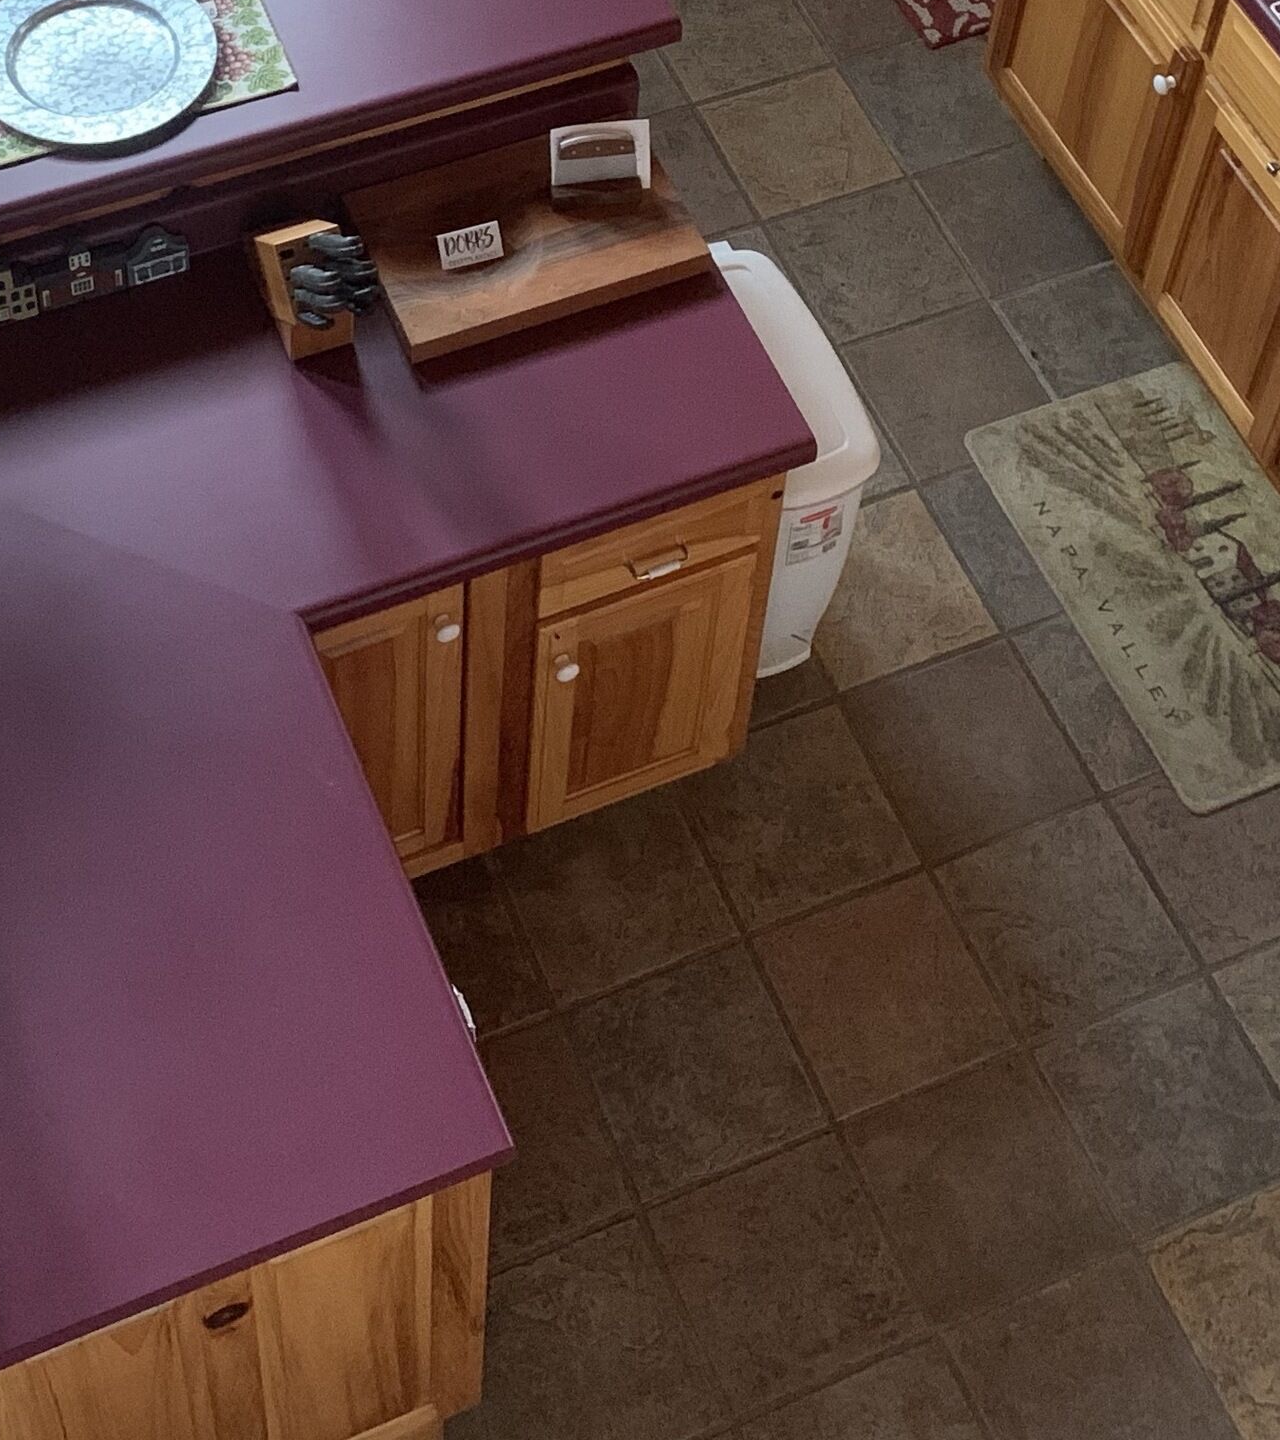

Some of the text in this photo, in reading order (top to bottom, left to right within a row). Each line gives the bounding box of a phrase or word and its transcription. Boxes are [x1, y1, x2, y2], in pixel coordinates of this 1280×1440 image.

[443, 225, 495, 257] DOBBS
[1033, 500, 1182, 720] NAPA VALLEY
